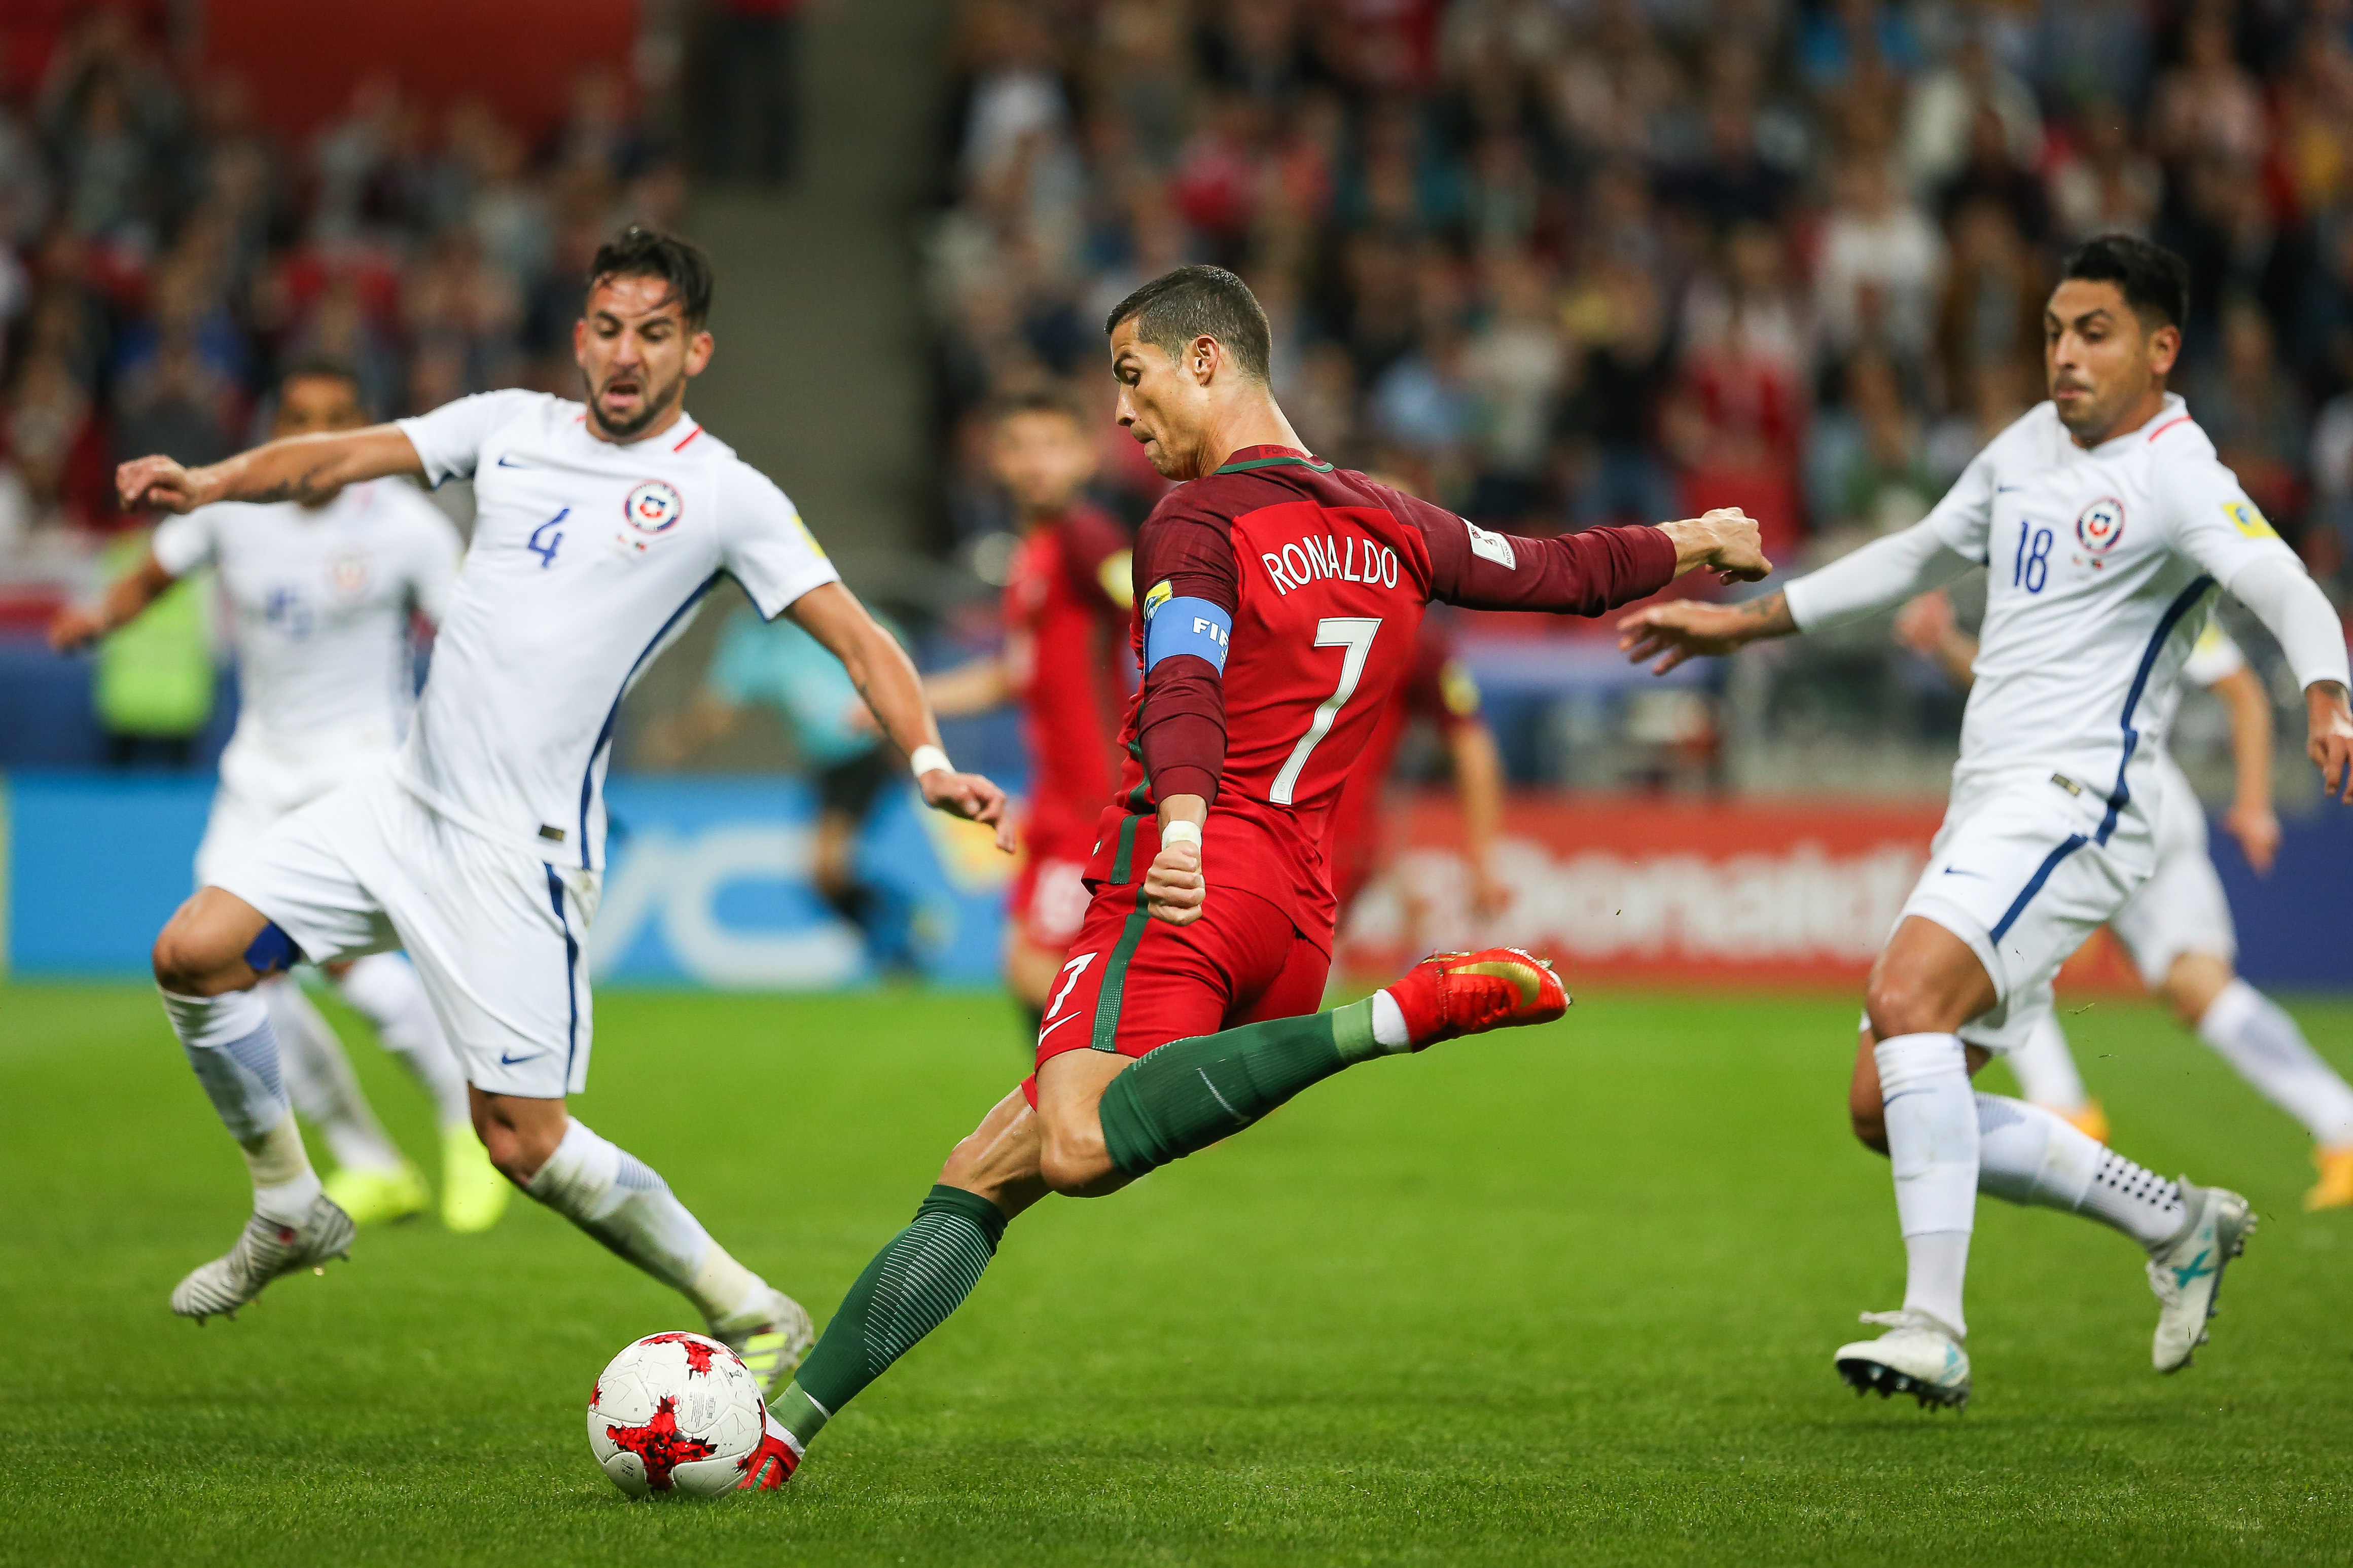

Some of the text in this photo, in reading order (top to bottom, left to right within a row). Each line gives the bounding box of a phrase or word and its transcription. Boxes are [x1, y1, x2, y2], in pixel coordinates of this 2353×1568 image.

[528, 507, 570, 568] 4
[1261, 534, 1398, 596] RONALDO
[2014, 521, 2053, 594] 18
[1193, 616, 1230, 648] FIF
[1269, 617, 1383, 805] 7
[1046, 952, 1098, 1020] 7
